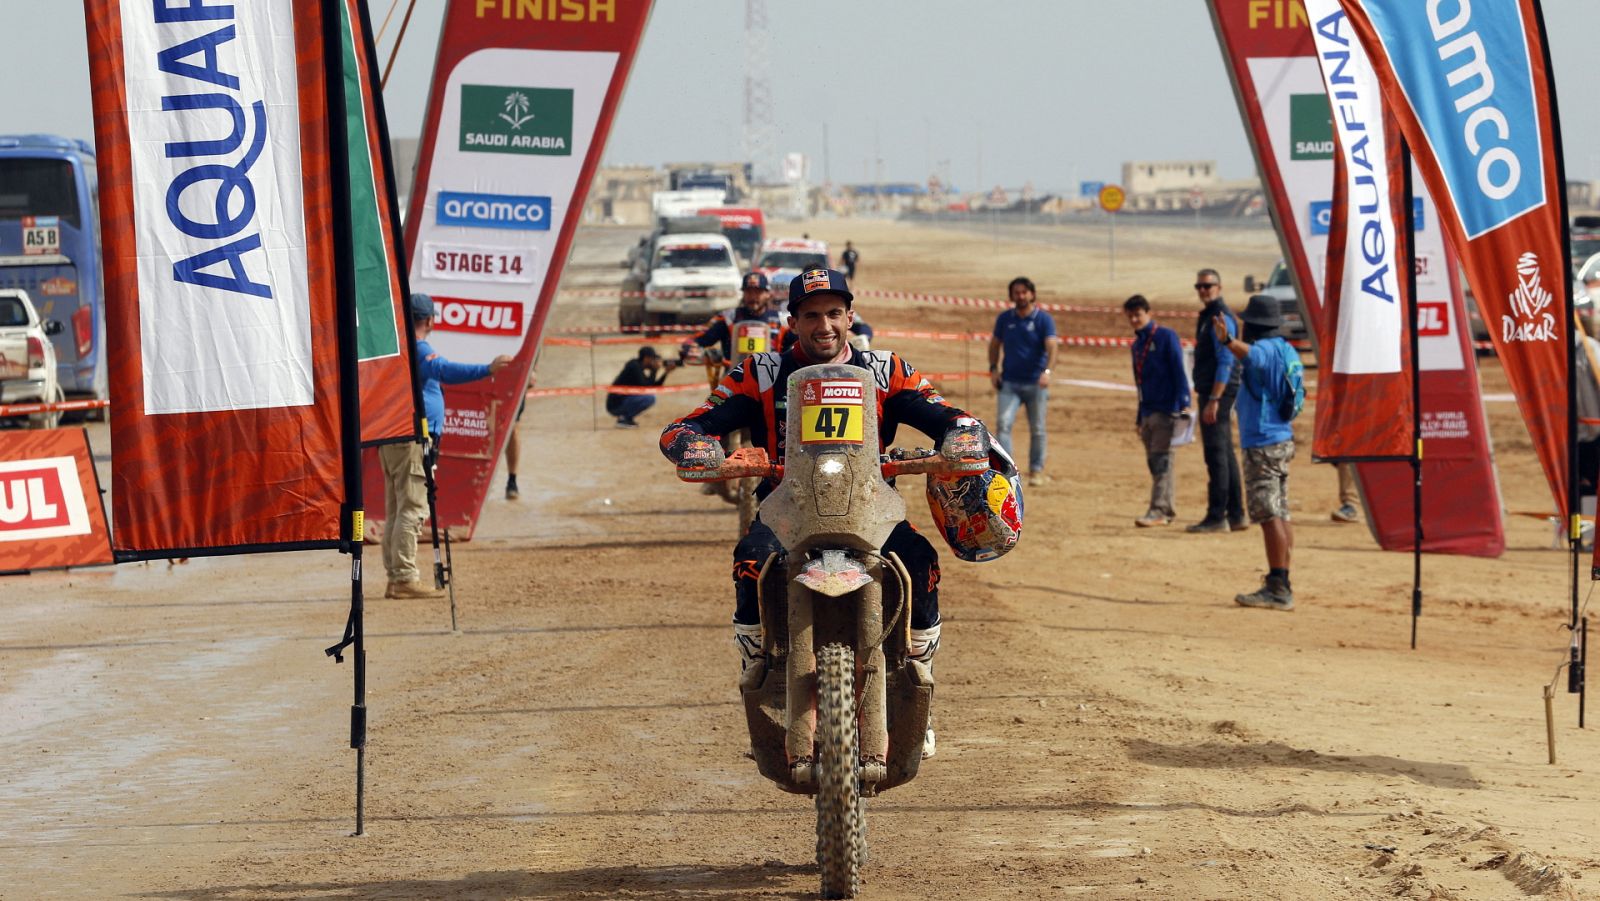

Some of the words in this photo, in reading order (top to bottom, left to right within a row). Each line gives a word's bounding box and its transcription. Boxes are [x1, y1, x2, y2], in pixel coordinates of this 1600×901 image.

[476, 0, 616, 23] FINISH
[465, 132, 508, 146] SAUDI
[511, 135, 566, 149] ARABIA
[1316, 10, 1395, 304] AQUAFINA
[444, 199, 544, 222] aramco
[26, 230, 44, 246] A5
[435, 251, 494, 273] STAGE
[499, 255, 523, 275] 14
[1502, 313, 1558, 343] DAKAR
[748, 338, 755, 351] 8
[824, 387, 861, 397] MOTUL
[457, 409, 486, 418] WORLD
[815, 407, 850, 438] 47
